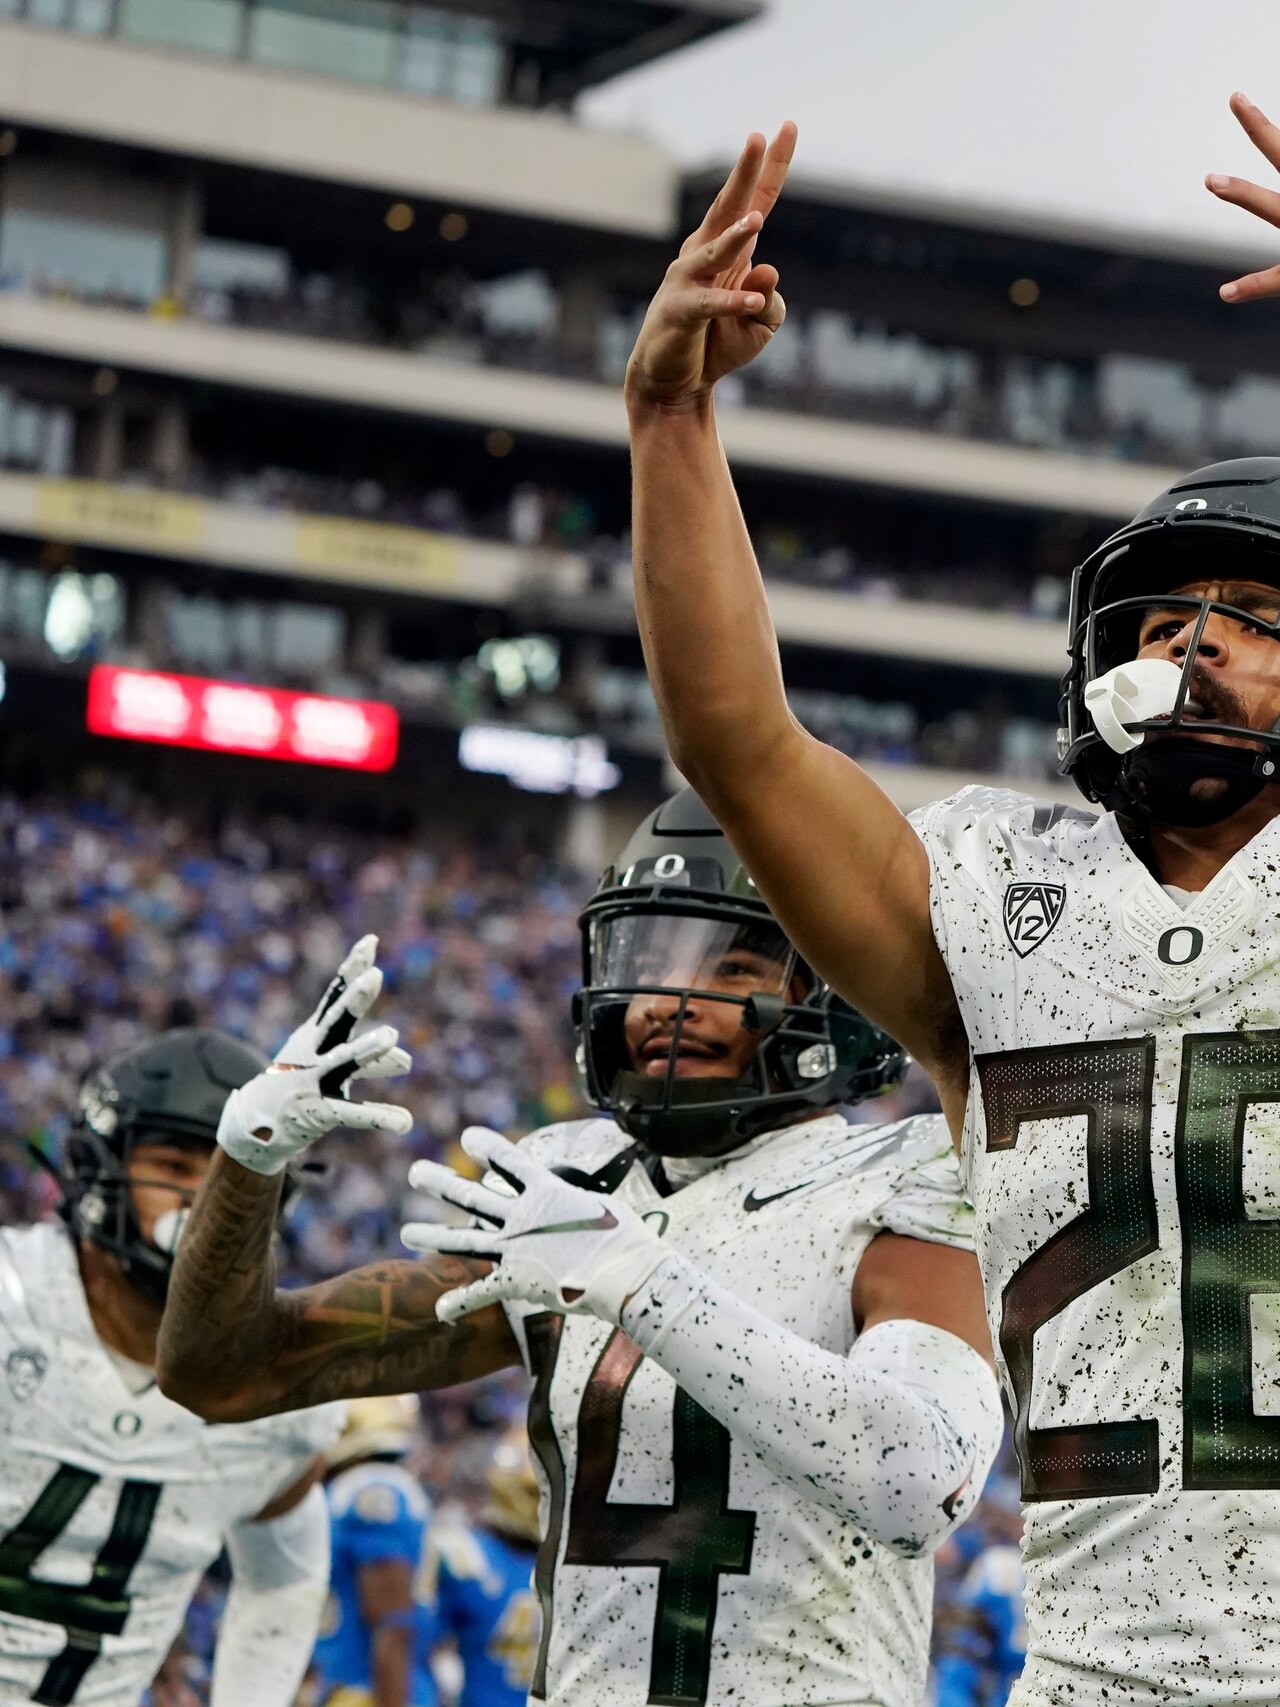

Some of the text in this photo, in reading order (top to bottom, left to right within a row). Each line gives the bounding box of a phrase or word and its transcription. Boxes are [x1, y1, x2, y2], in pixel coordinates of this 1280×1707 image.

[1008, 886, 1062, 927] PAC
[1014, 915, 1044, 941] 12
[1157, 926, 1204, 966] O
